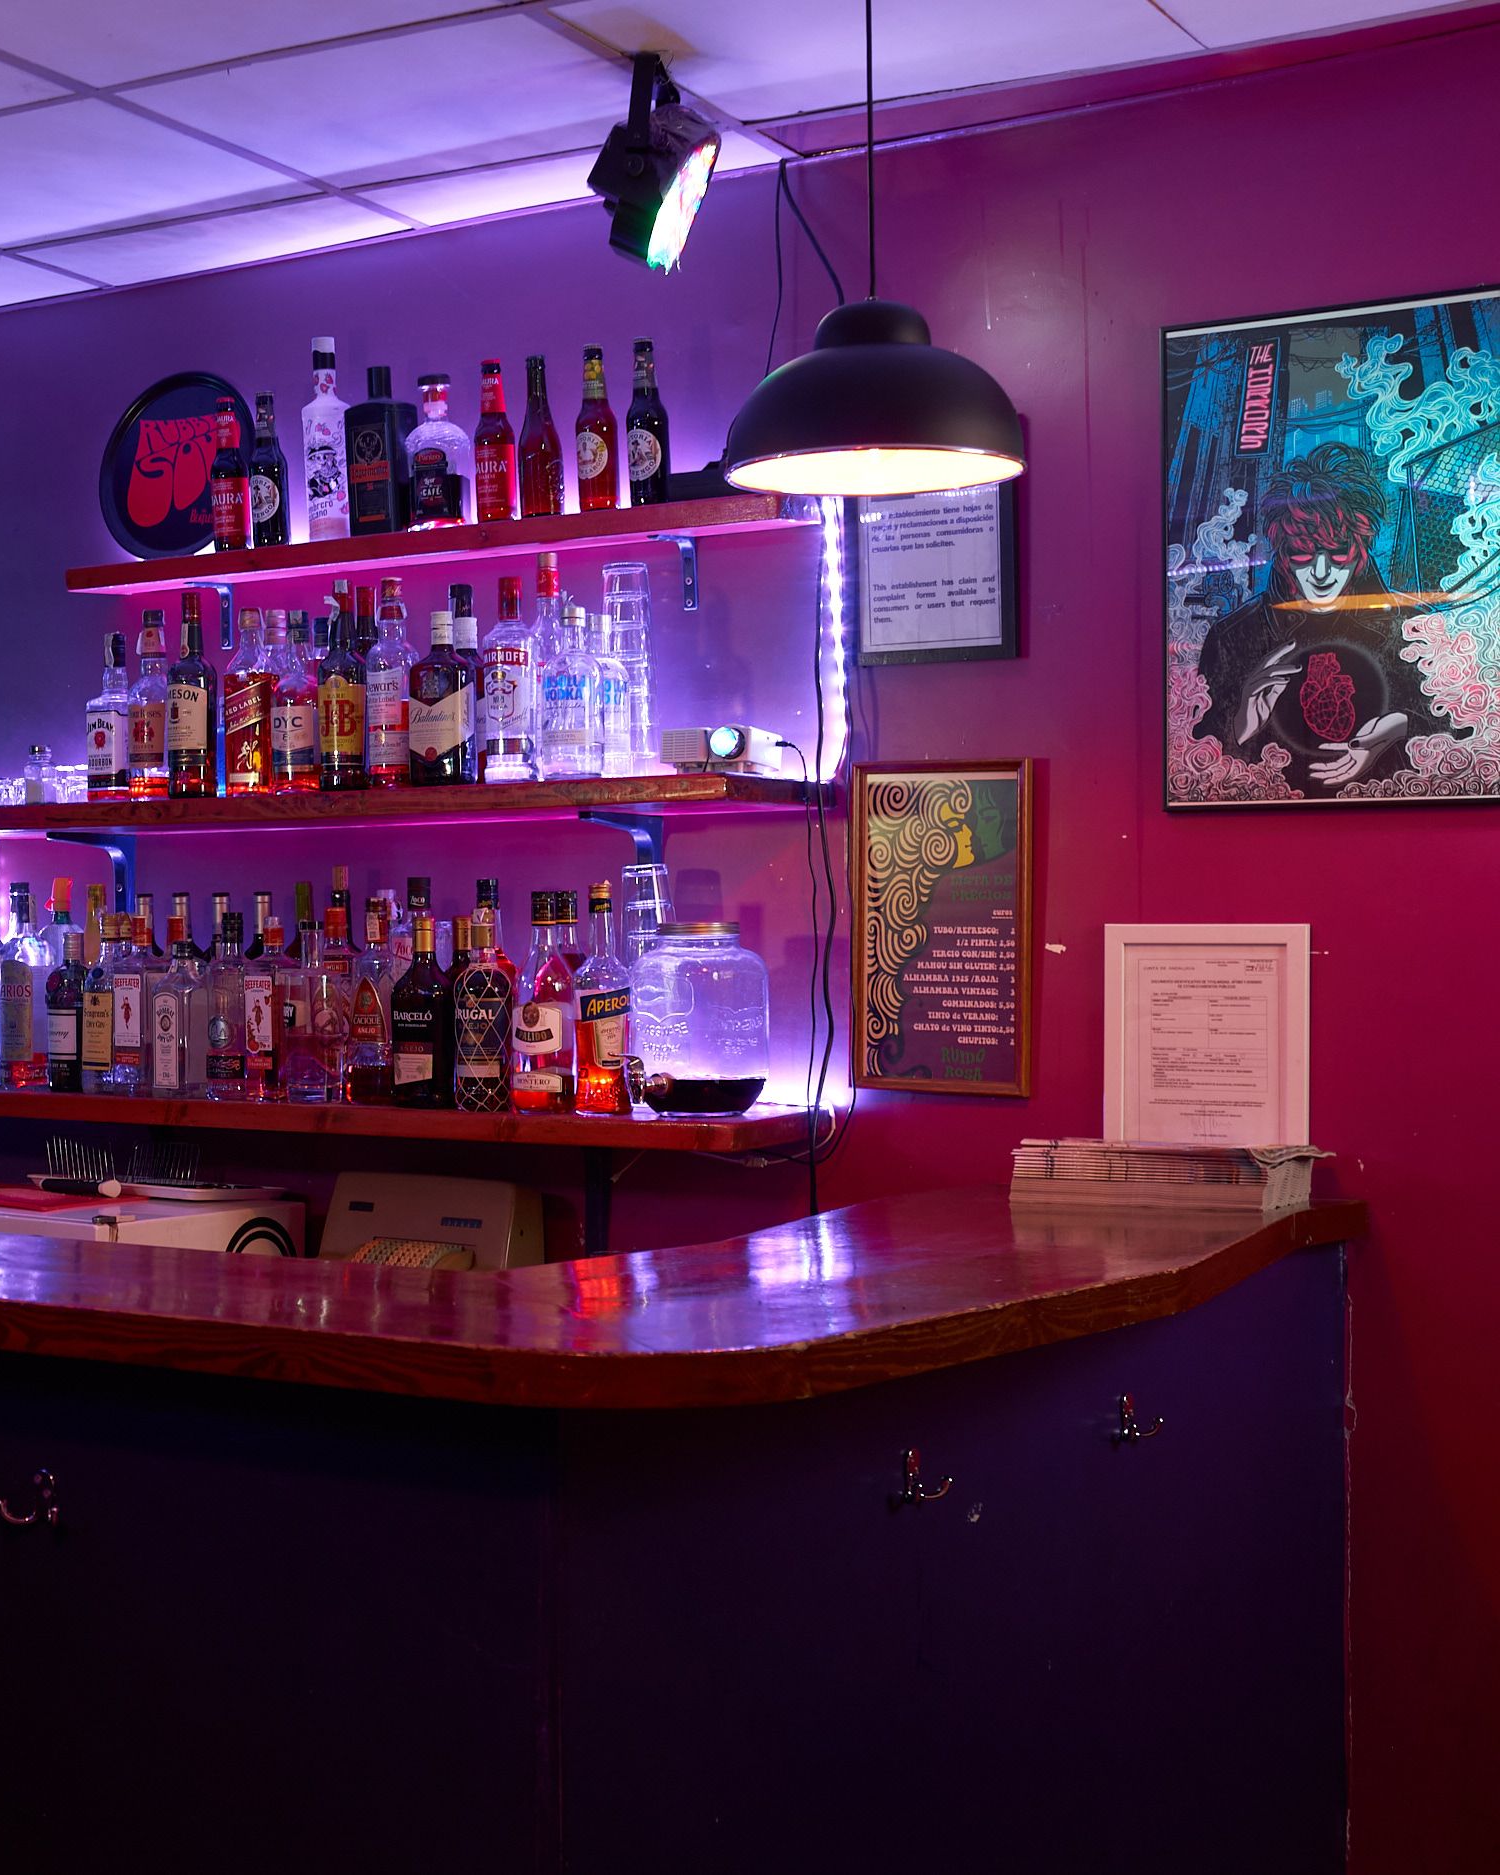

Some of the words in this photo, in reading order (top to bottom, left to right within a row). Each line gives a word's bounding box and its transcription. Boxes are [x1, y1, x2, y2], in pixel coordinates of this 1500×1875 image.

[1249, 344, 1274, 365] THE
[1240, 363, 1273, 450] HORRORS
[943, 505, 960, 513] tiene
[963, 503, 982, 515] hojas
[985, 502, 994, 510] de
[900, 517, 949, 529] reclamaciones
[956, 512, 995, 525] disposición
[901, 530, 931, 542] personas
[936, 524, 984, 537] consumidoras
[901, 543, 914, 552] que
[915, 541, 925, 550] las
[873, 582, 888, 592] This
[891, 579, 938, 591] establishment
[942, 577, 955, 586] has
[958, 576, 978, 586] claim
[982, 574, 996, 583] and
[874, 593, 907, 604] complaint
[917, 590, 937, 599] forms
[947, 586, 977, 597] available
[988, 586, 996, 594] to
[874, 604, 910, 614] consumers
[915, 603, 923, 611] or
[927, 601, 947, 610] users
[951, 599, 965, 608] that
[970, 596, 997, 608] request
[874, 615, 893, 624] them.
[545, 686, 583, 701] VODKA
[239, 695, 263, 711] LABEL
[273, 716, 303, 729] DYC
[933, 926, 999, 935] TUBO/REFRESCO:
[970, 939, 998, 947] PINTA:
[932, 950, 960, 958] TERCIO
[962, 950, 998, 959] CON/SIN:
[917, 961, 948, 969] MAHOU
[949, 961, 964, 970] SIN
[965, 962, 998, 971] GLUTEN:
[114, 978, 140, 989] BEEFEATER
[903, 973, 949, 982] ALHAMBRA
[970, 974, 999, 983] /ROJA:
[0, 984, 33, 999] ARIOS
[913, 986, 960, 996] ALHAMBRA
[961, 987, 999, 996] VINTAGE:
[942, 1000, 998, 1009] COMBINADOS:
[393, 1009, 433, 1023] BARCELÓ
[927, 1011, 951, 1020] TINTO
[952, 1012, 961, 1020] de
[962, 1012, 999, 1021] VERANO:
[913, 1023, 940, 1032] CHATO
[941, 1024, 950, 1032] de
[951, 1025, 972, 1033] VINO
[973, 1025, 999, 1034] TINTO:
[957, 1036, 999, 1045] CHUPITOS:
